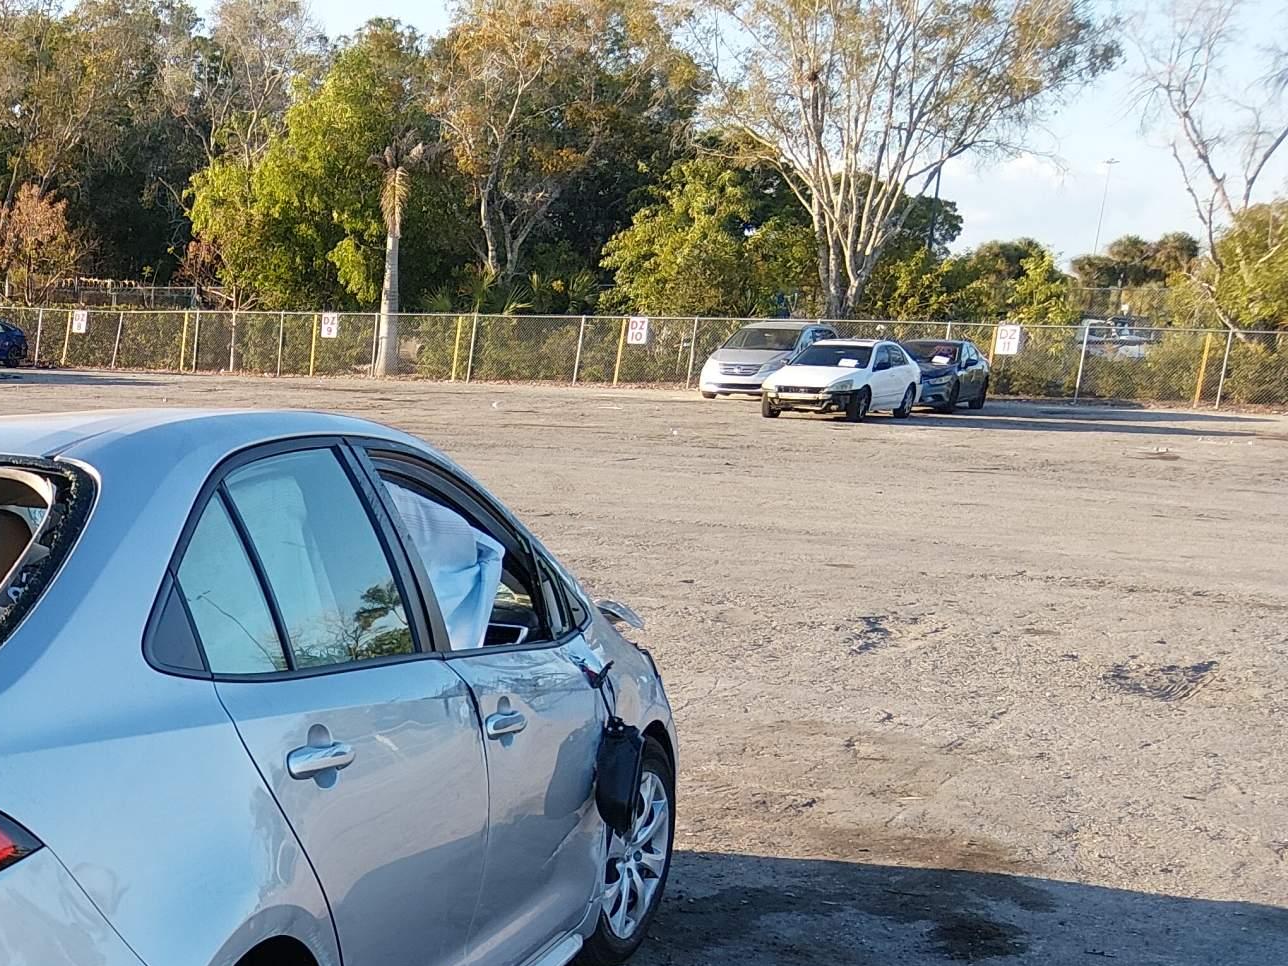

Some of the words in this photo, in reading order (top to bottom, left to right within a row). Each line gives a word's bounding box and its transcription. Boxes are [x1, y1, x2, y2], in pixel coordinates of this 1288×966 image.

[323, 316, 336, 325] DZ
[631, 320, 645, 330] DZ
[631, 331, 643, 342] 10
[1000, 329, 1017, 339] DZ
[1002, 341, 1010, 352] 11
